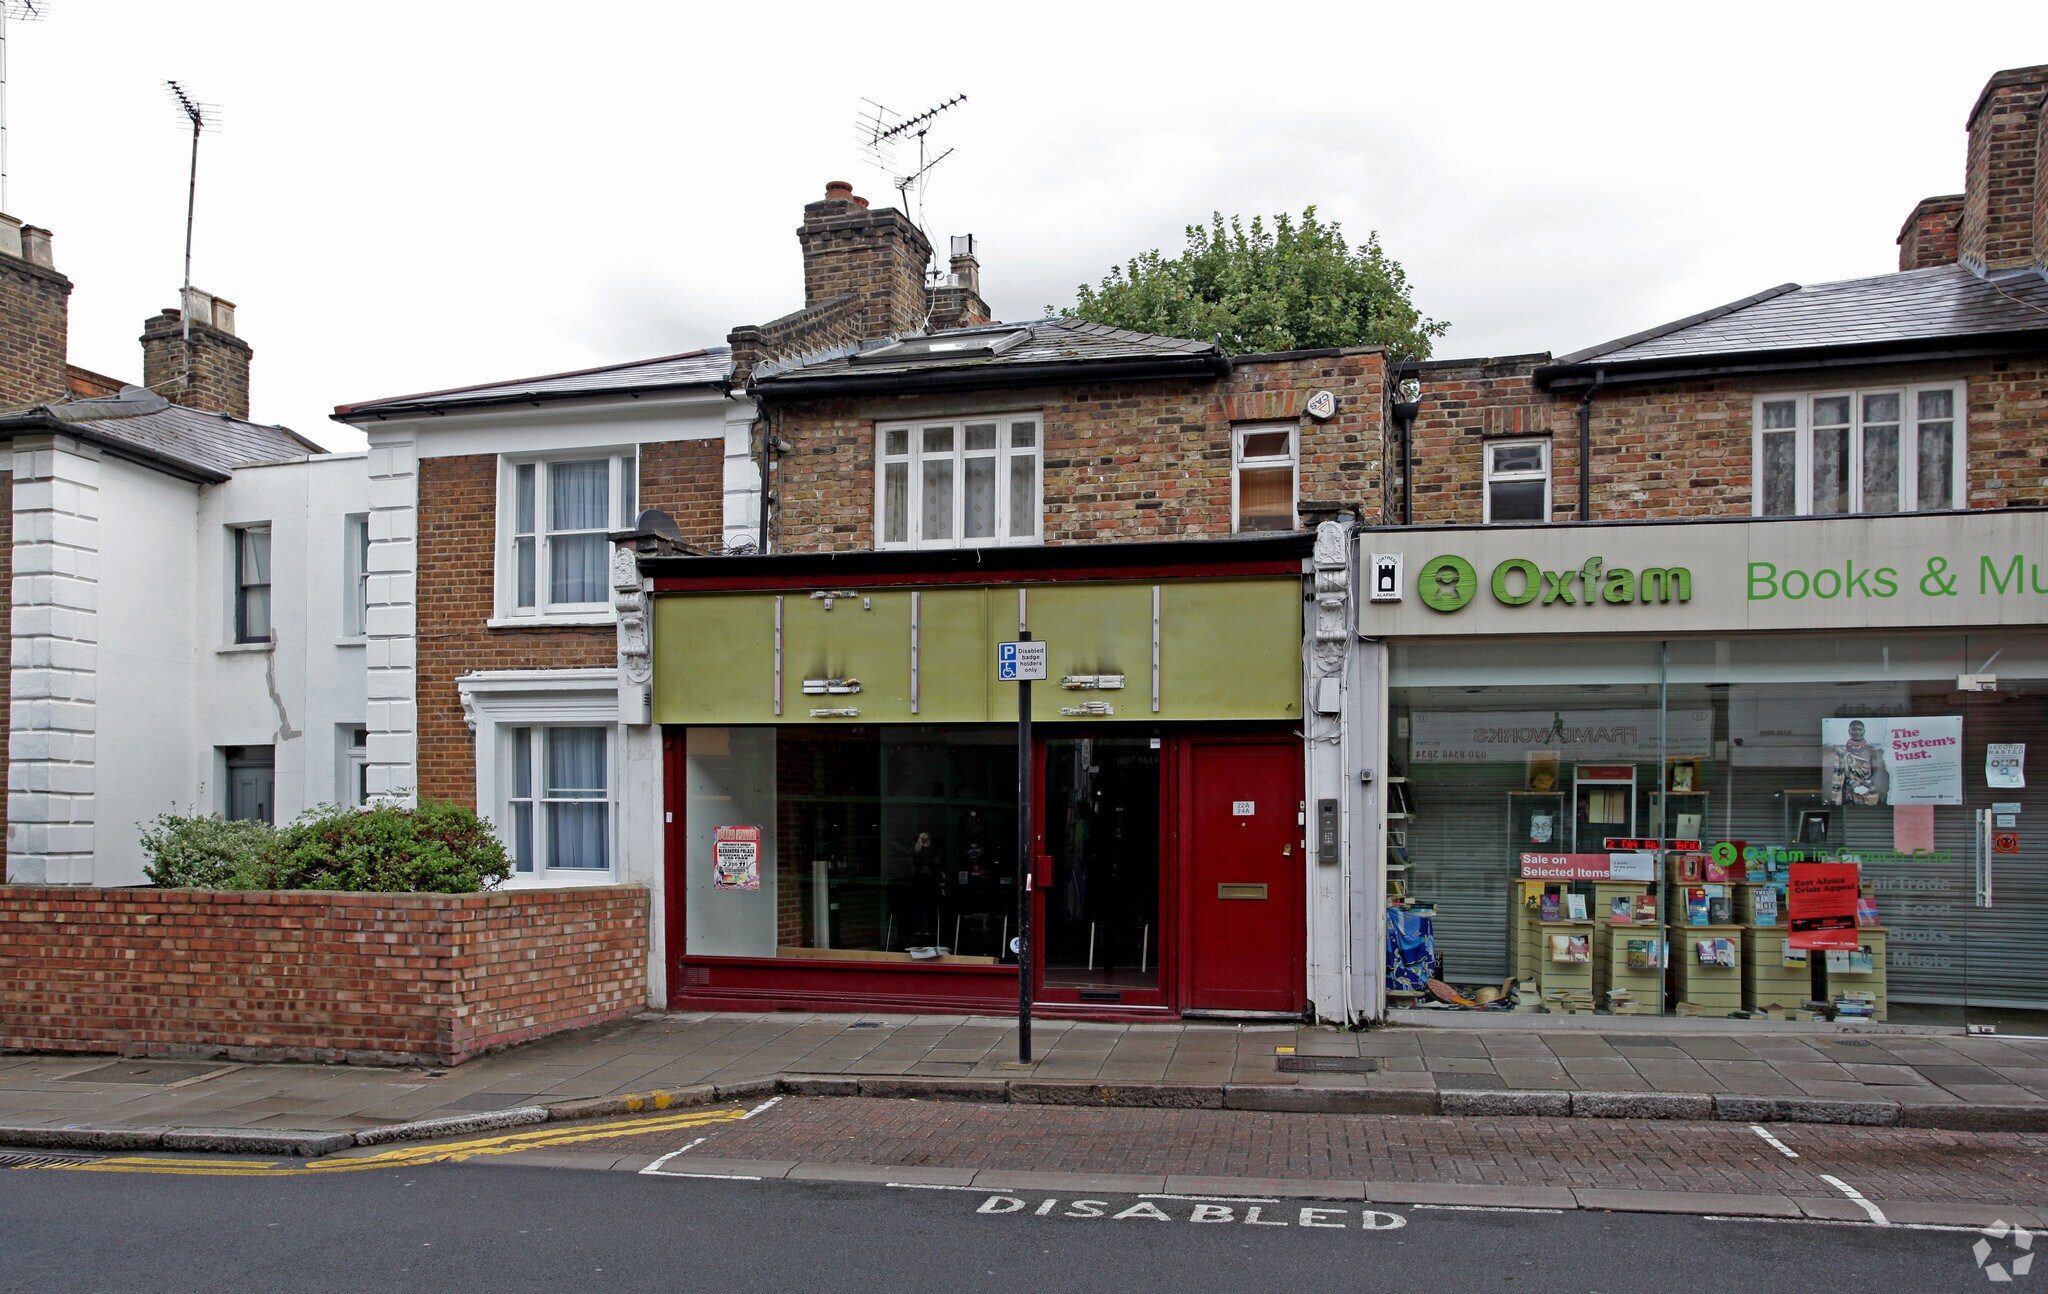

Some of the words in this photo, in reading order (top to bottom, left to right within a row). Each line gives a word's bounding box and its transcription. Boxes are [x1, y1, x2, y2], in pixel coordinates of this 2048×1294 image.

[1309, 393, 1330, 411] CAS
[1490, 556, 1693, 606] Oxfam
[1747, 559, 1899, 601] Books
[1918, 555, 1958, 597] &
[1004, 646, 1015, 660] P
[1890, 728, 1920, 739] The
[1891, 736, 1956, 752] System's
[1894, 749, 1932, 761] bust.
[1606, 839, 1615, 849] 2
[1621, 839, 1638, 849] ON
[1523, 854, 1548, 864] Sale
[1551, 856, 1567, 864] on
[1743, 846, 1804, 862] Oxfam
[1812, 847, 1828, 862] in
[1835, 847, 1905, 862] Crouch
[1913, 847, 1952, 863] End
[1523, 866, 1574, 877] Selected
[1577, 867, 1610, 878] Items
[1816, 877, 1845, 885] Africa
[1794, 885, 1821, 893] Crisis
[1823, 883, 1856, 893] Appeal
[1901, 903, 1951, 916] Food
[1892, 952, 1951, 967] Music
[975, 1195, 1408, 1231] DISABLED
